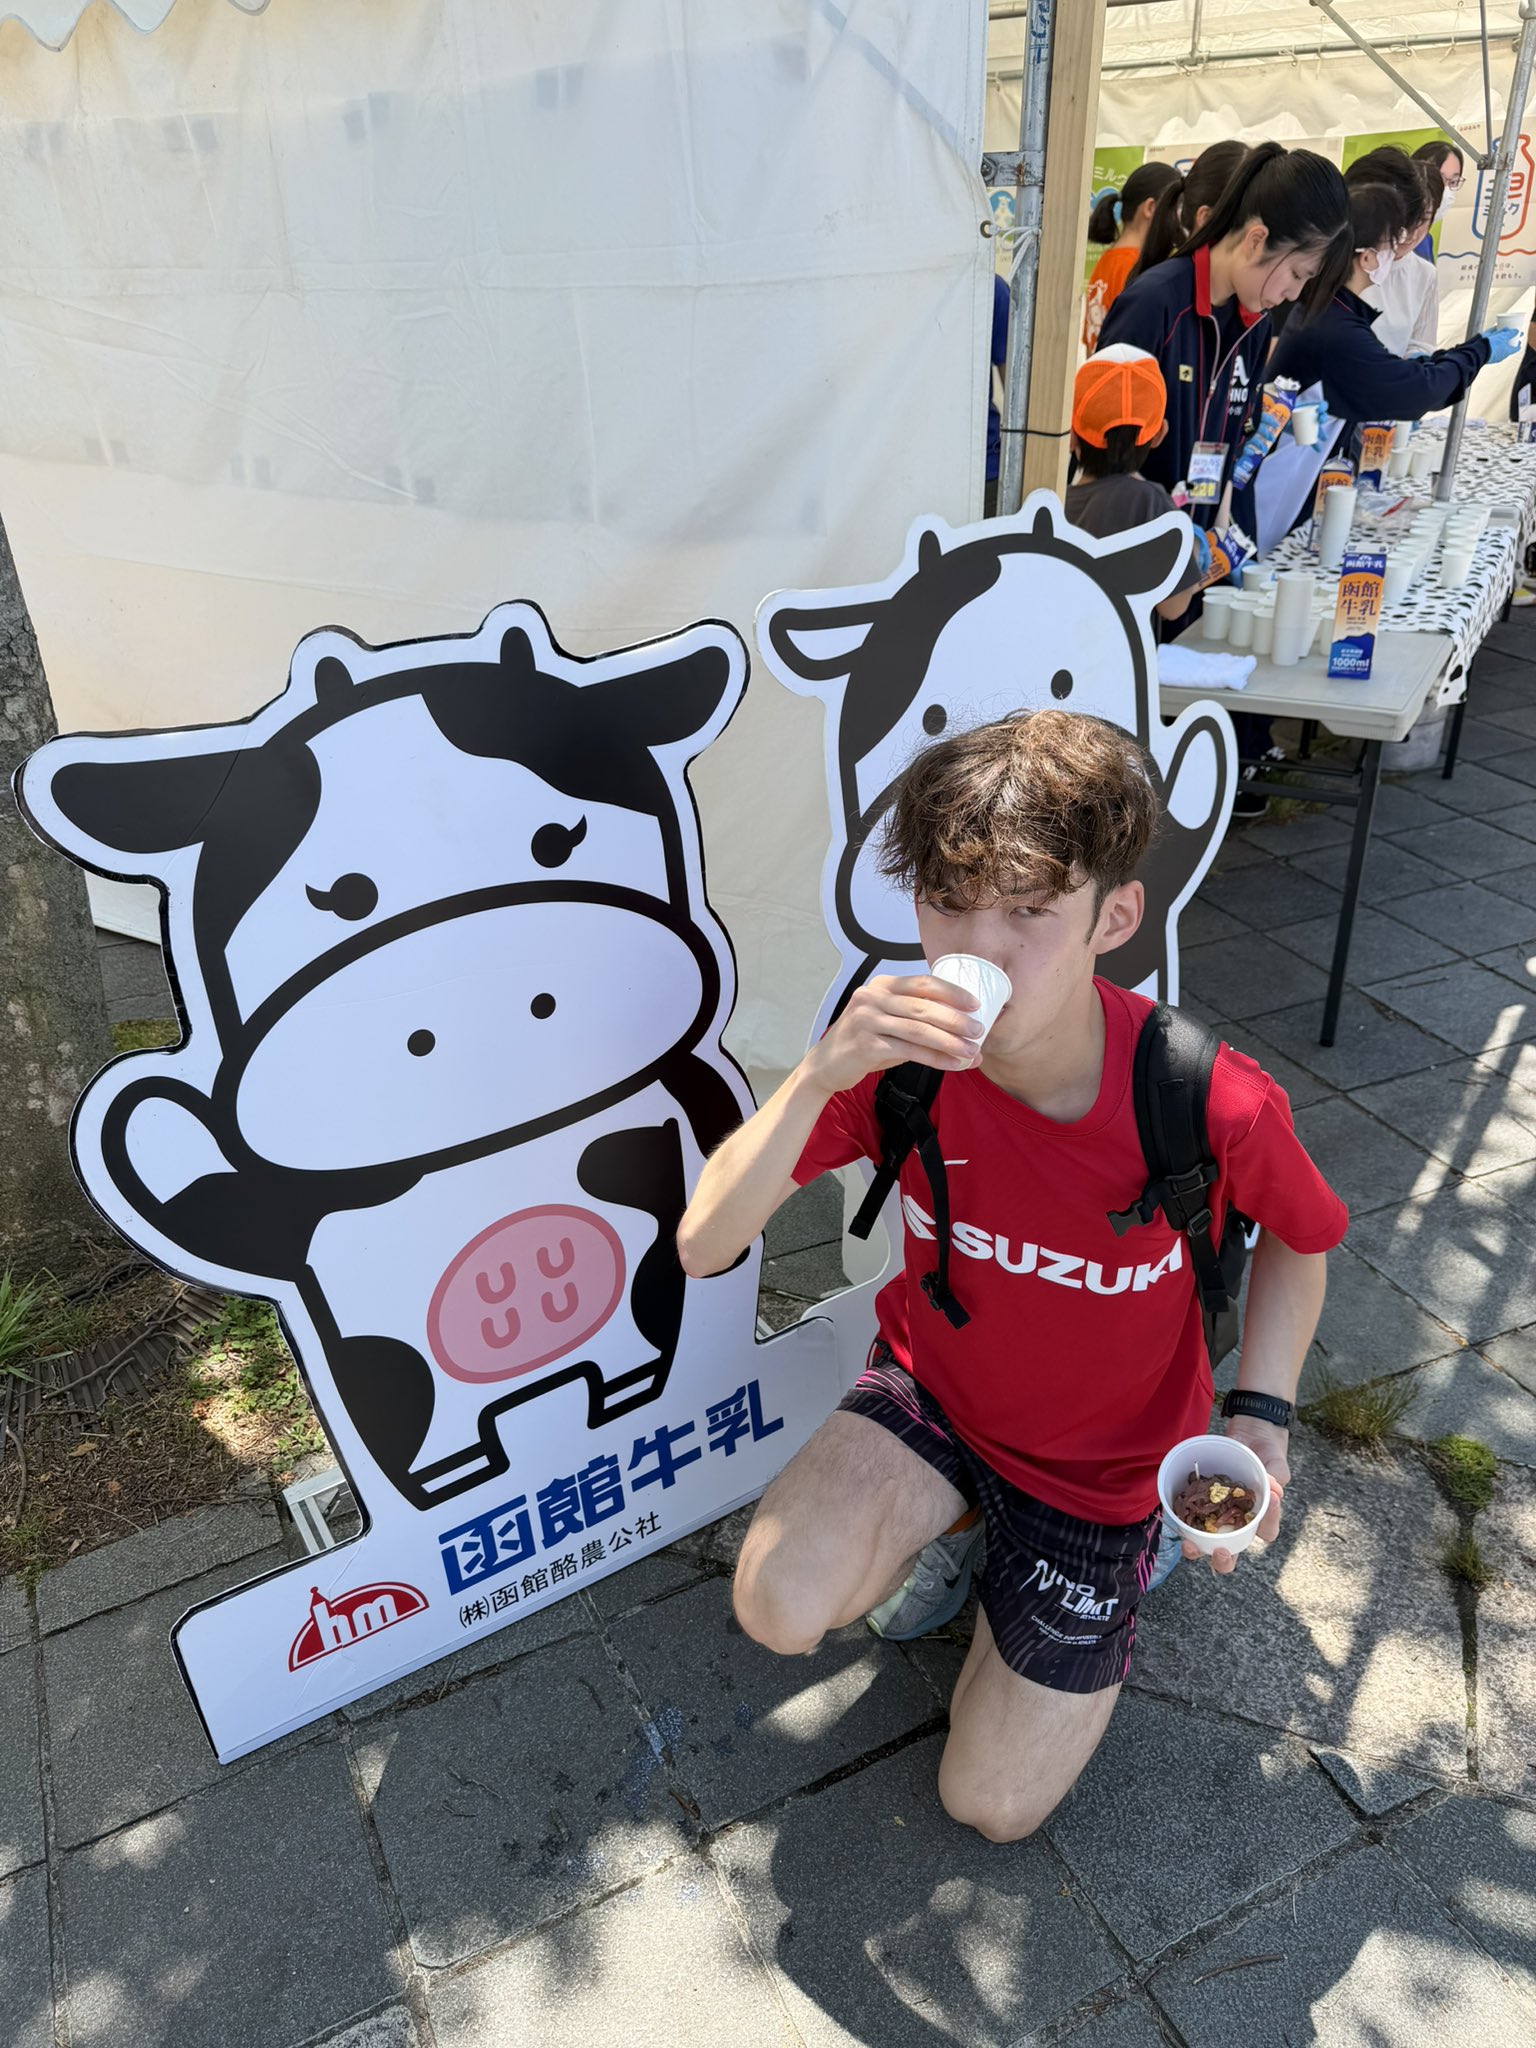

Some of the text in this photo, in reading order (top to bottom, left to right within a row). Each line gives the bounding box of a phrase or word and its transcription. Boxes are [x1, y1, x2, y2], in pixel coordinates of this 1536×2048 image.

[1341, 580, 1380, 599] 函館
[1341, 598, 1377, 616] 牛乳
[1332, 657, 1370, 668] 1000ml
[438, 1379, 785, 1596] 函館牛乳
[459, 1511, 662, 1628] (株)函館酪農公社
[1060, 1590, 1119, 1616] LIMIT
[1031, 1615, 1064, 1639] CHALLENGE
[1079, 1614, 1111, 1622] ATHLETE
